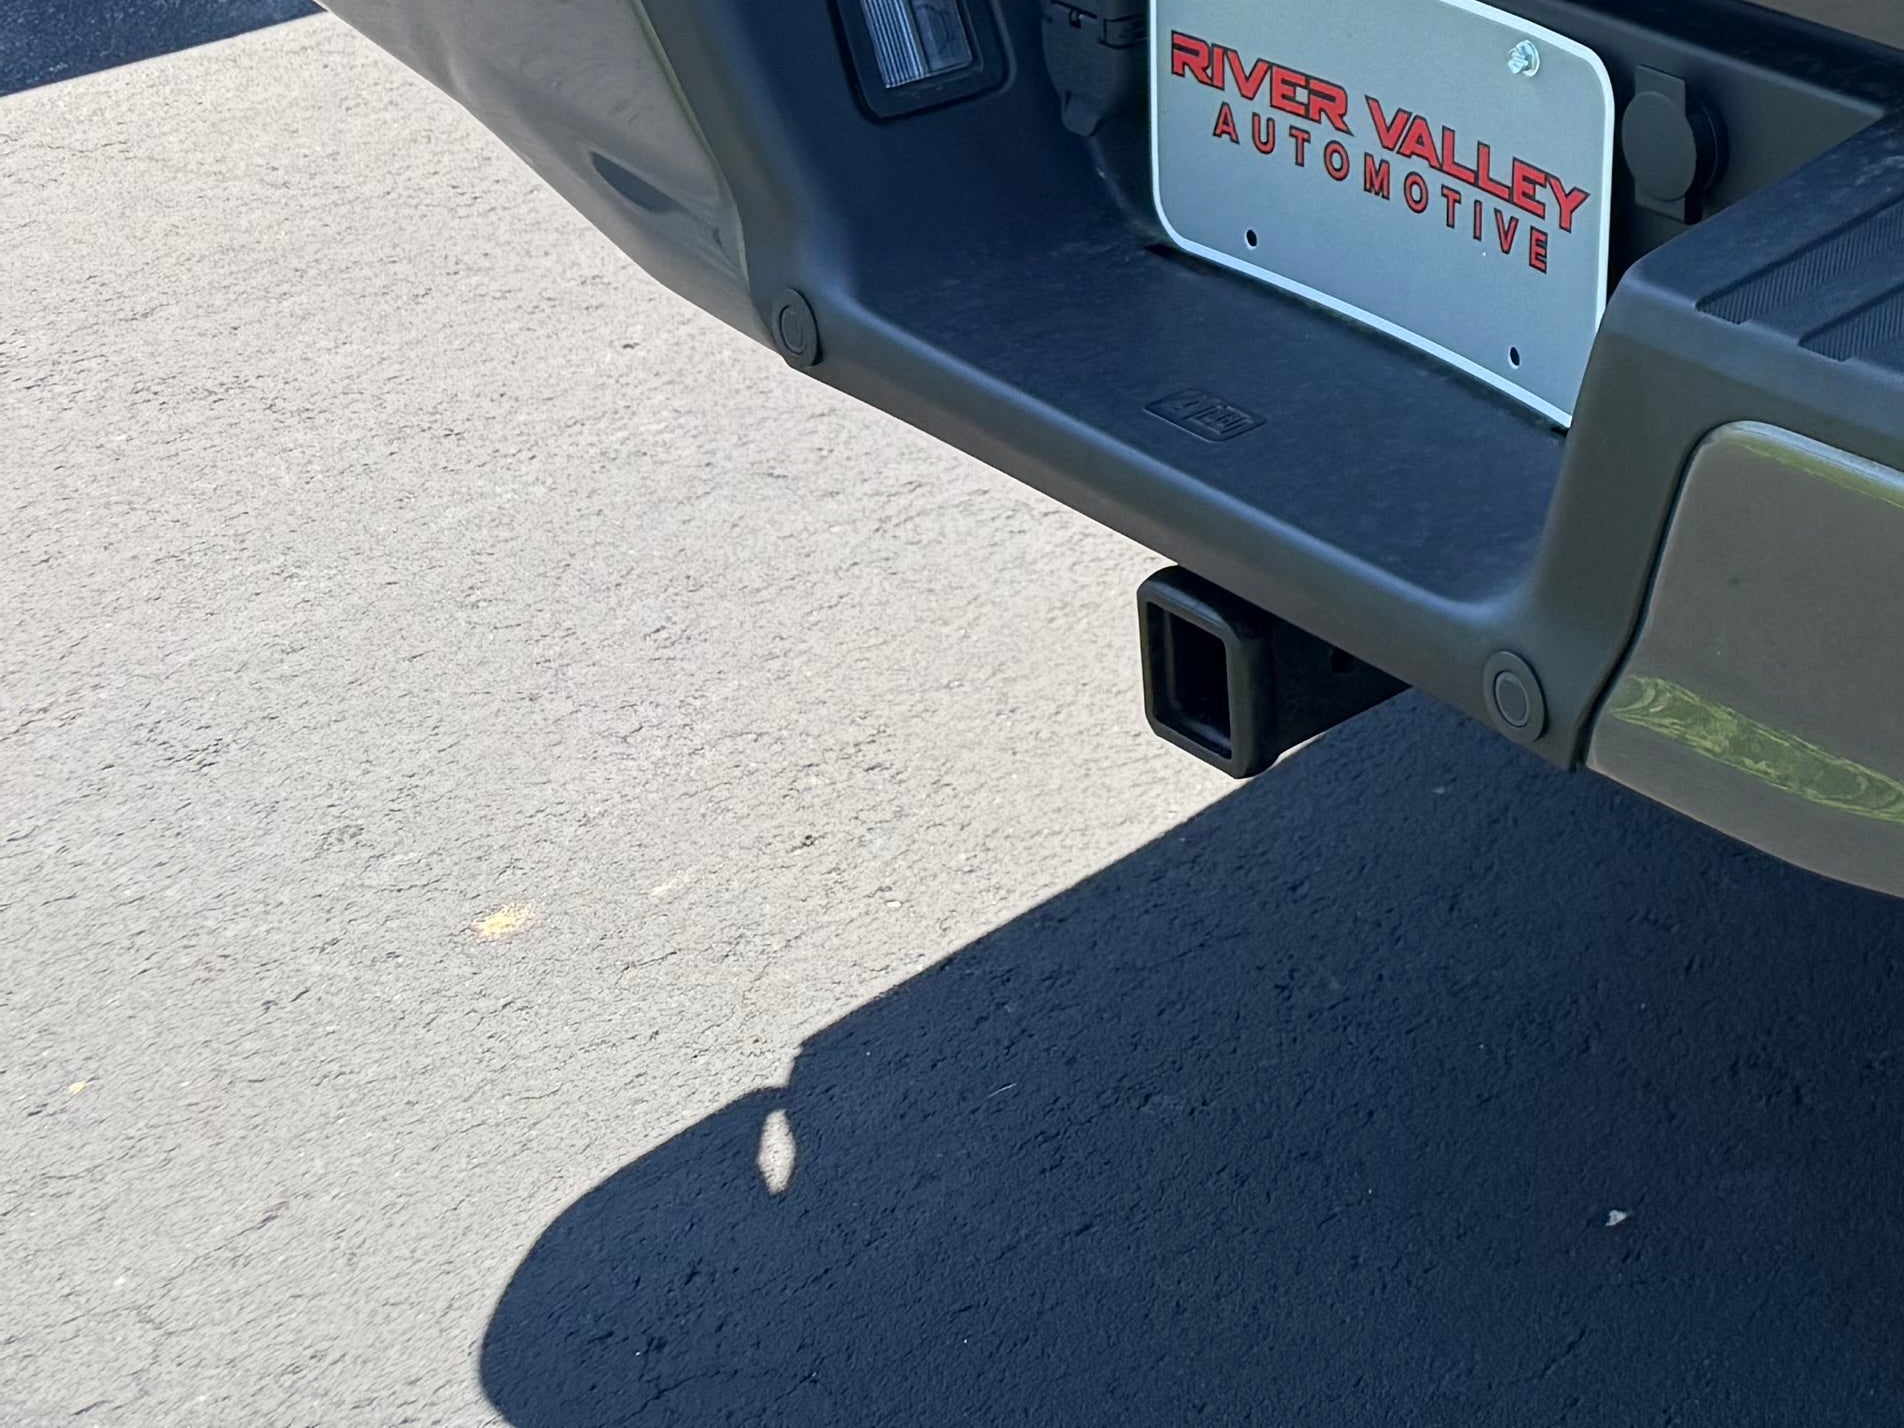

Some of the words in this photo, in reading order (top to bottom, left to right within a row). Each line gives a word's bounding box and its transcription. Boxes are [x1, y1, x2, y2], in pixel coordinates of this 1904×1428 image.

[1170, 29, 1354, 137] RIVER
[1364, 94, 1592, 232] VALLEY
[1213, 101, 1549, 274] AUTOMOTIVE
